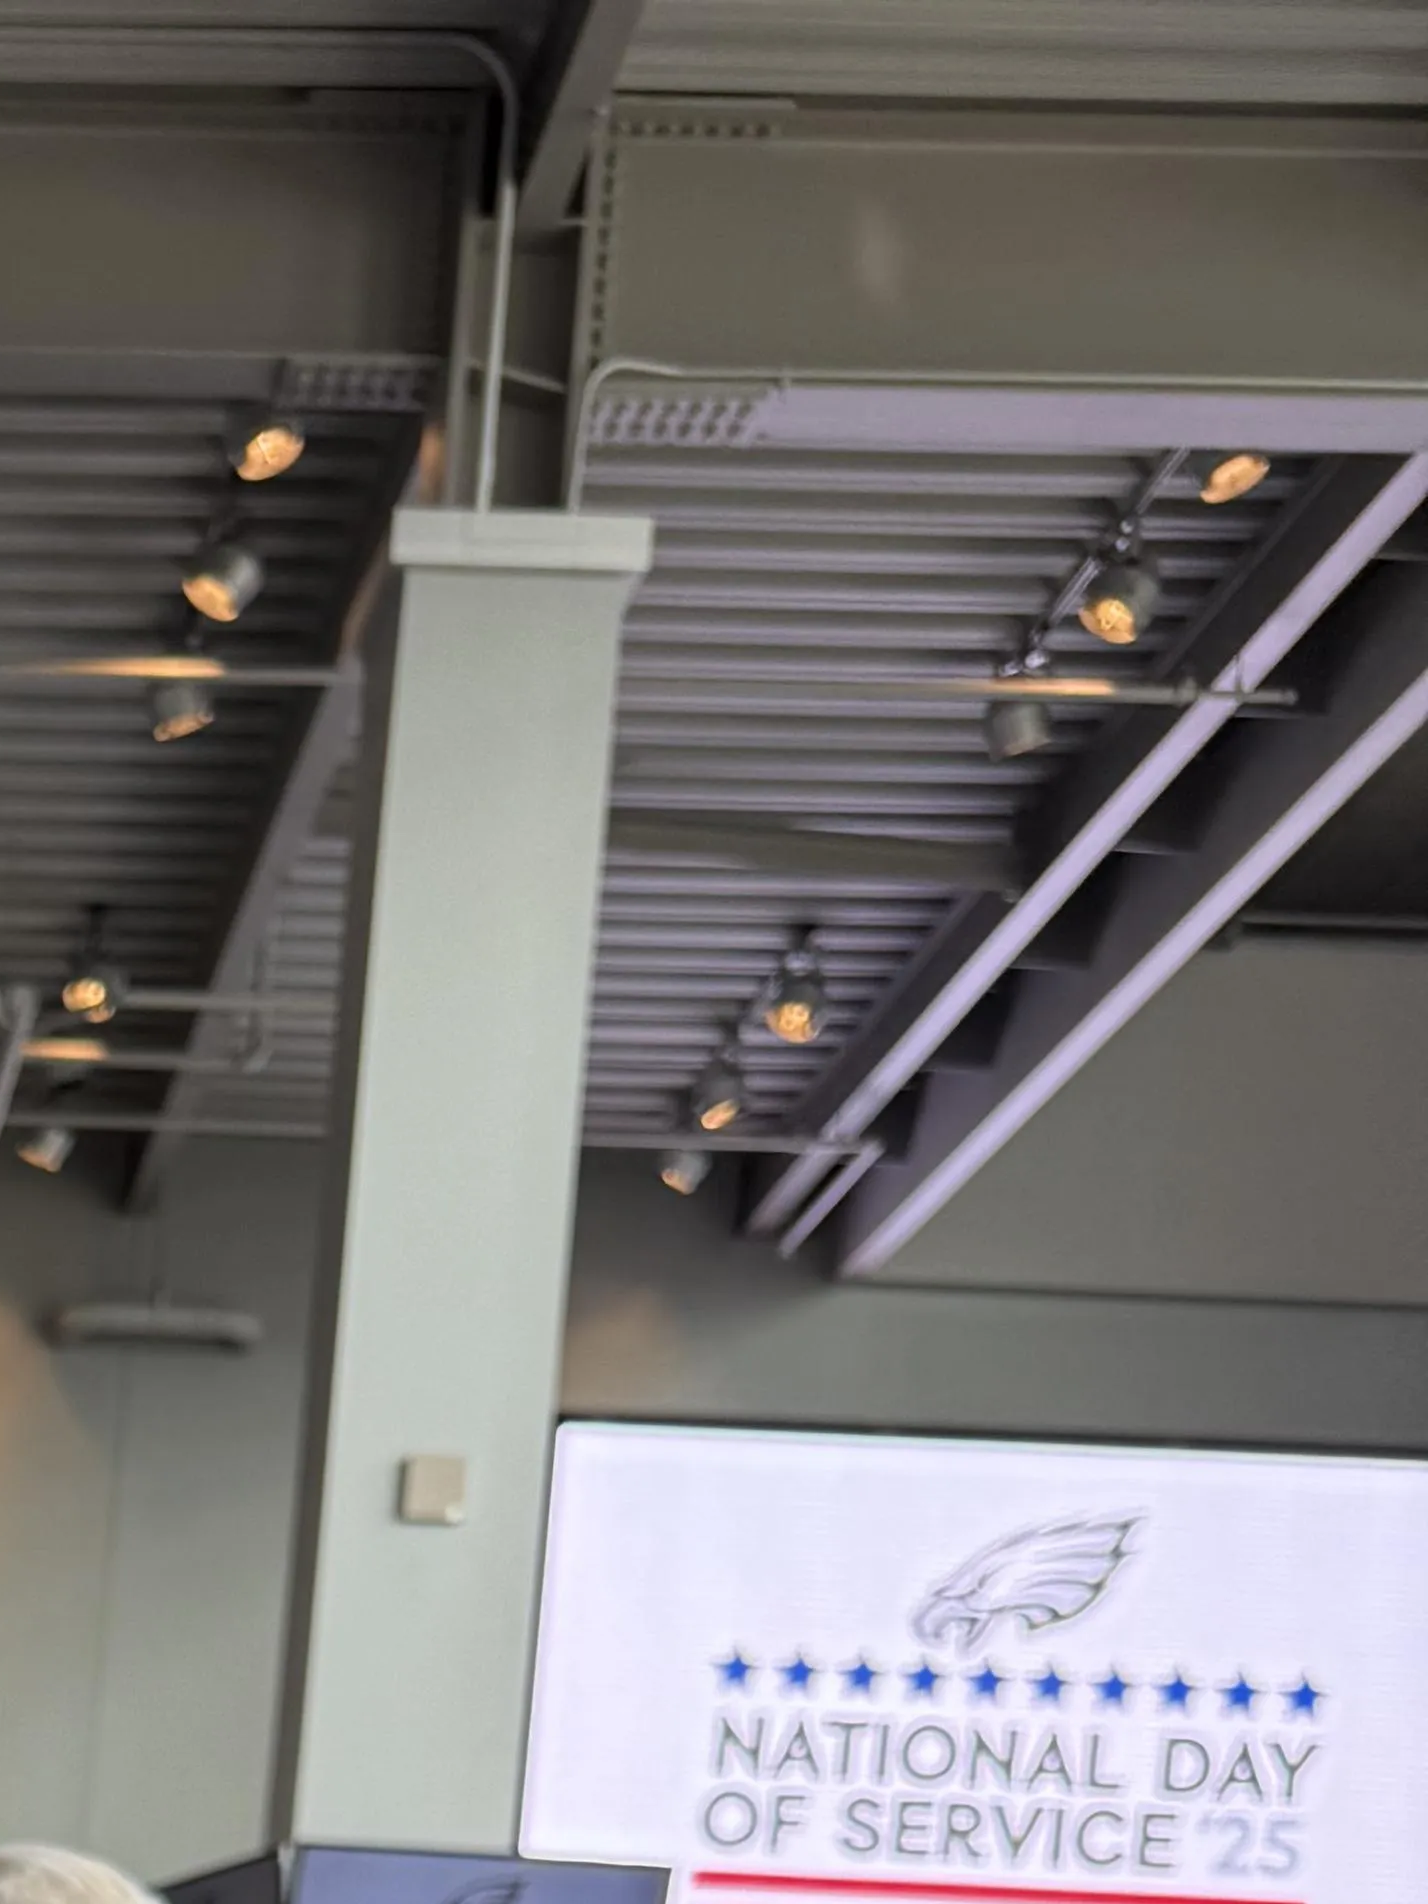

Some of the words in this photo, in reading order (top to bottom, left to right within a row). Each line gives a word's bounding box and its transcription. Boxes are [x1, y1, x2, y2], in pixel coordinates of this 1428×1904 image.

[715, 1715, 1123, 1792] NATIONAL
[1164, 1737, 1318, 1801] DAY
[704, 1792, 806, 1854] OF
[843, 1799, 1179, 1868] SERVICE
